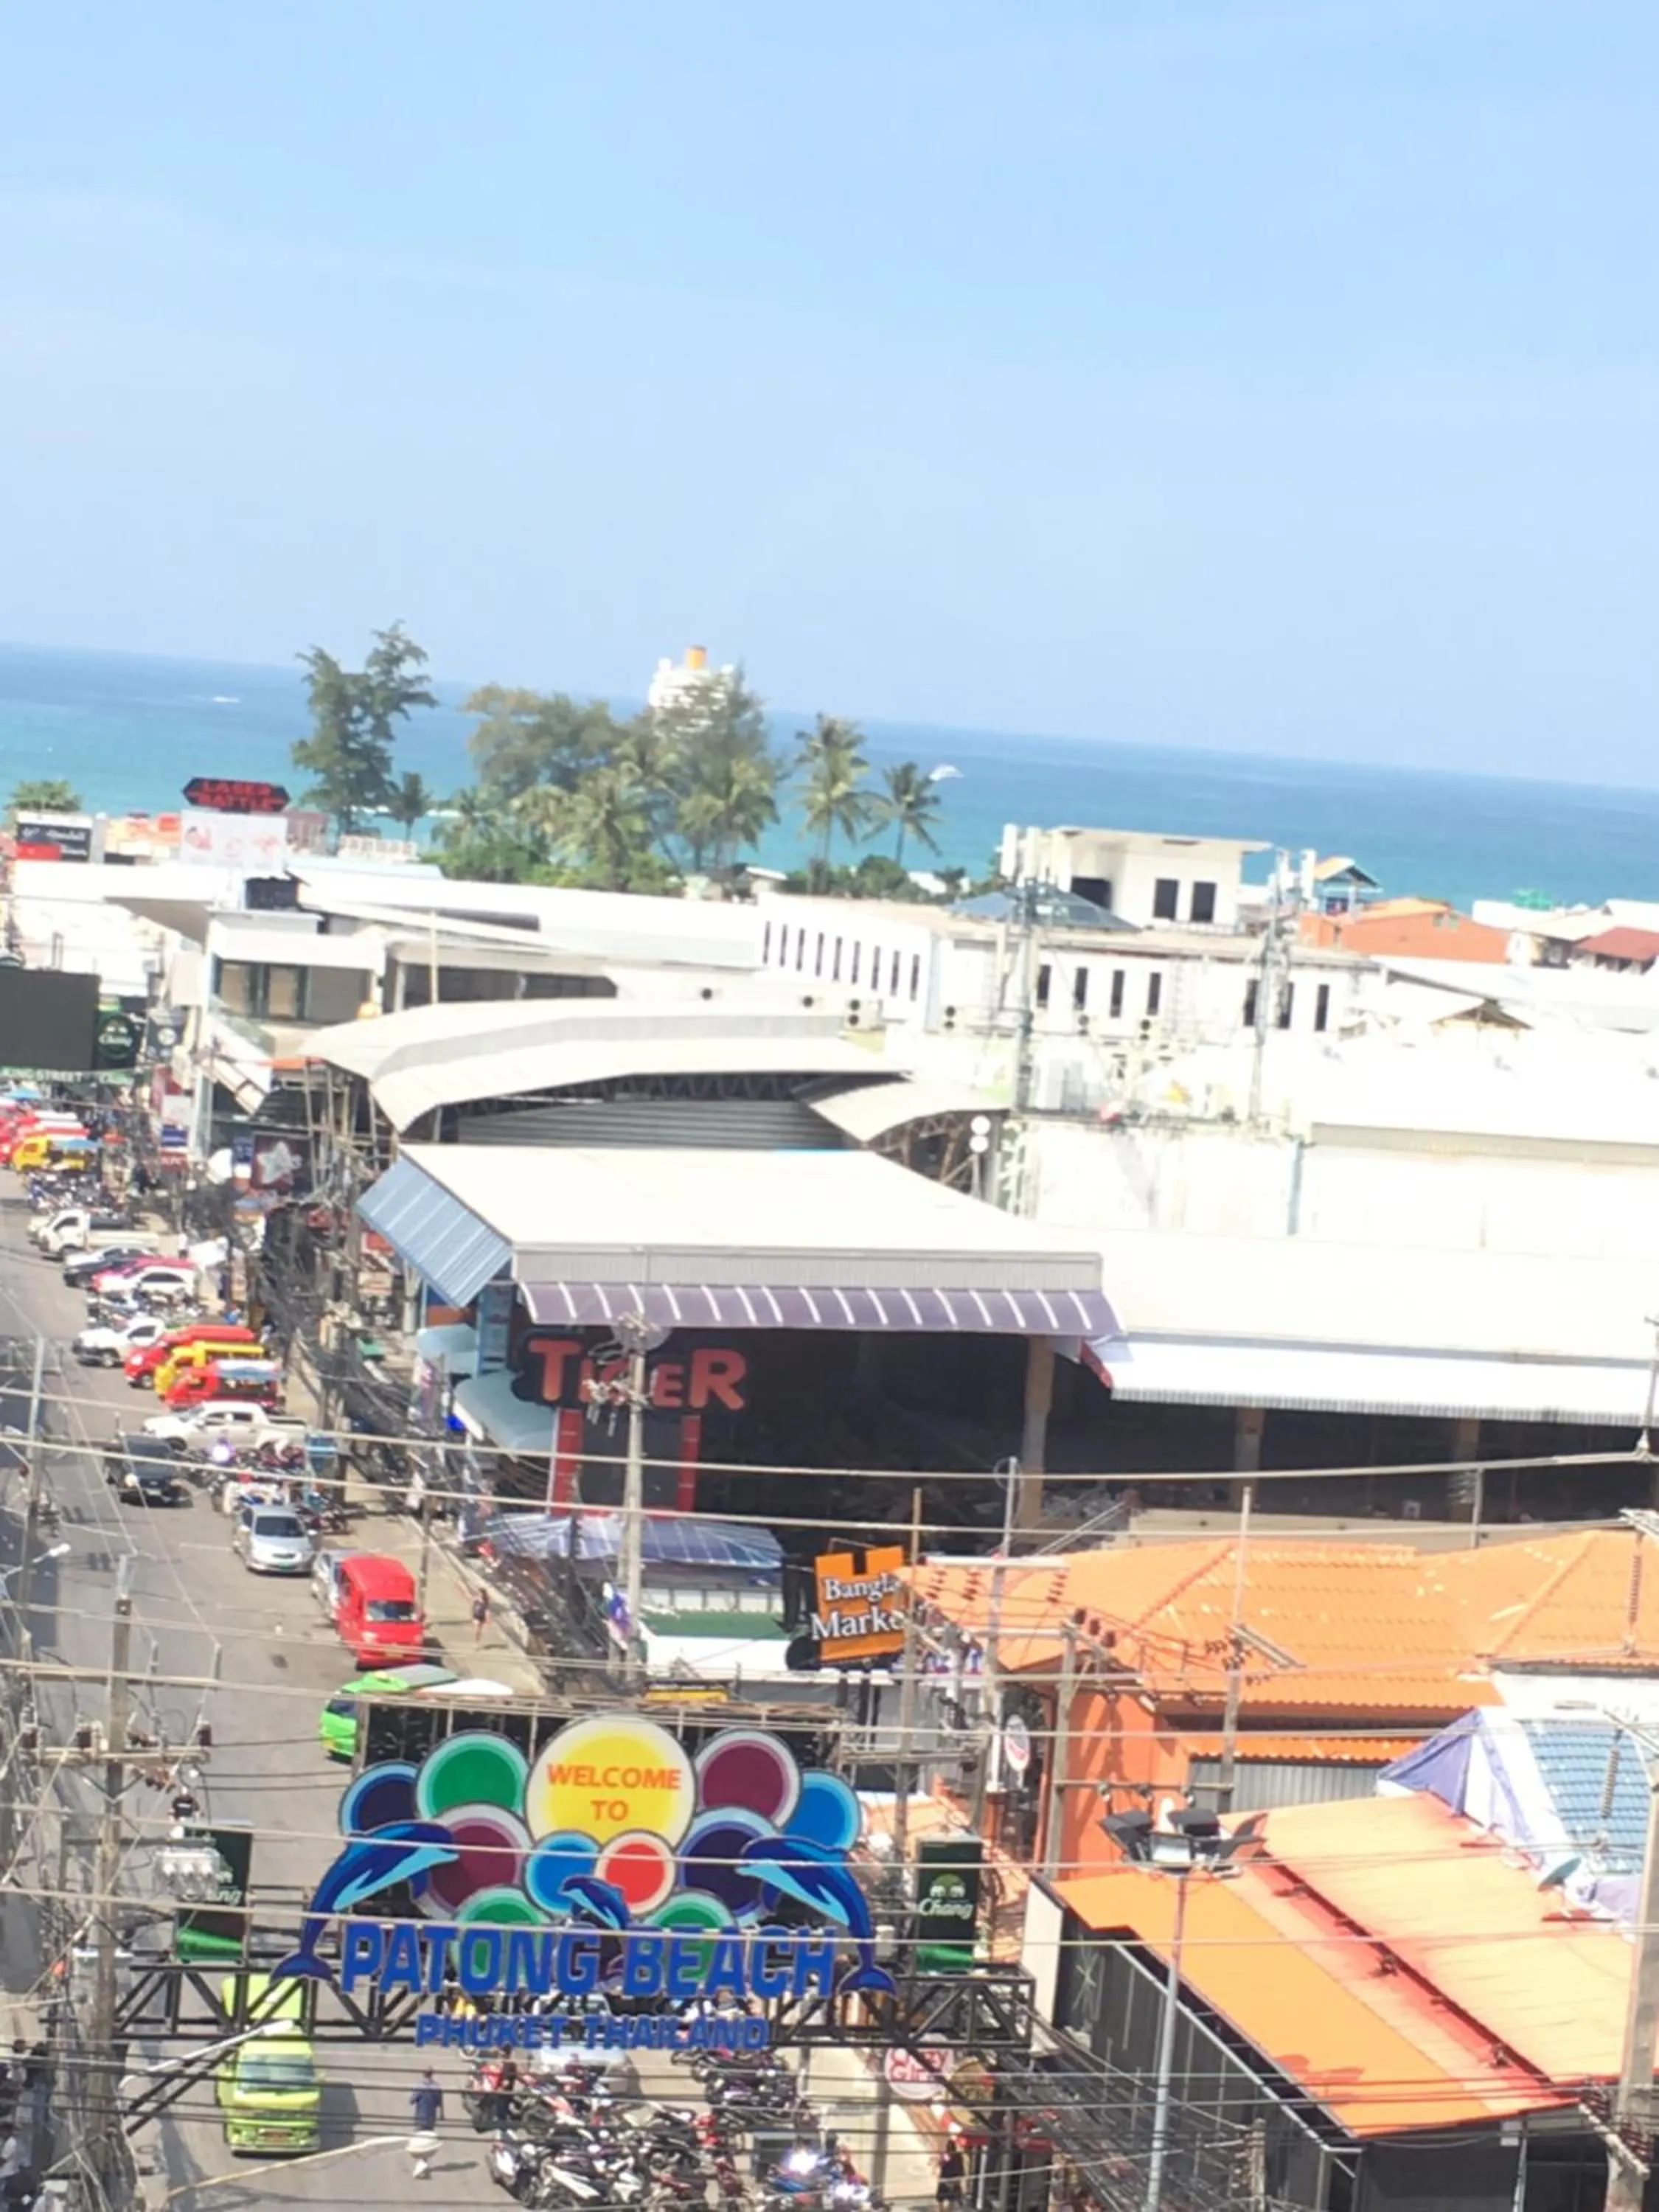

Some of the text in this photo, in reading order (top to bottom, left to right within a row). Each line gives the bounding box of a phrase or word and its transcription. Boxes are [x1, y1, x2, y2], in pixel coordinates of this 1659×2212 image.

[810, 1606, 905, 1641] Marke
[547, 1764, 682, 1790] WELCOME
[590, 1799, 629, 1822] TO
[919, 1898, 974, 1920] Chang
[341, 1921, 838, 1999] PATONG BEACH
[414, 2014, 770, 2051] PHUKET THAILAND
